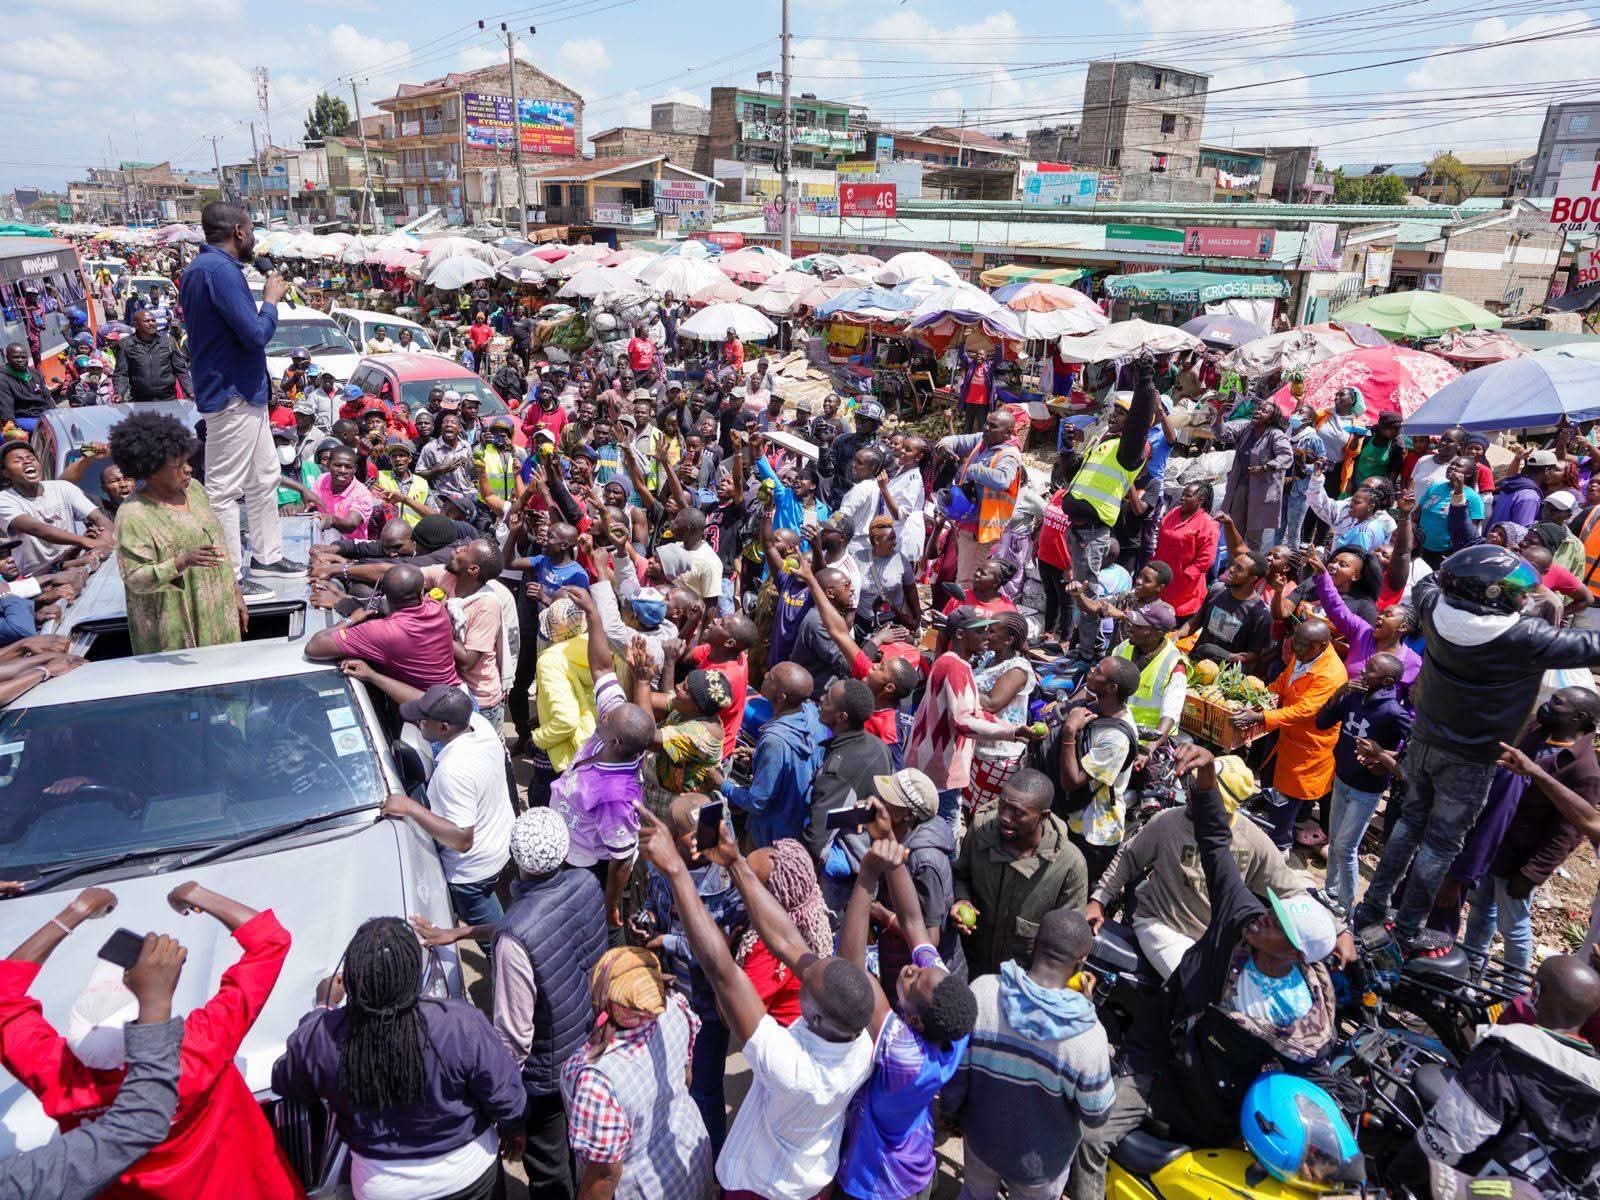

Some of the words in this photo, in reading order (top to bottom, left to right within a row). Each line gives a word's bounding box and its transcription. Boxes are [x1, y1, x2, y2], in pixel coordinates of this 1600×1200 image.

[877, 192, 893, 208] 4G
[1558, 223, 1587, 231] RUAI
[1169, 290, 1198, 301] TISSUE
